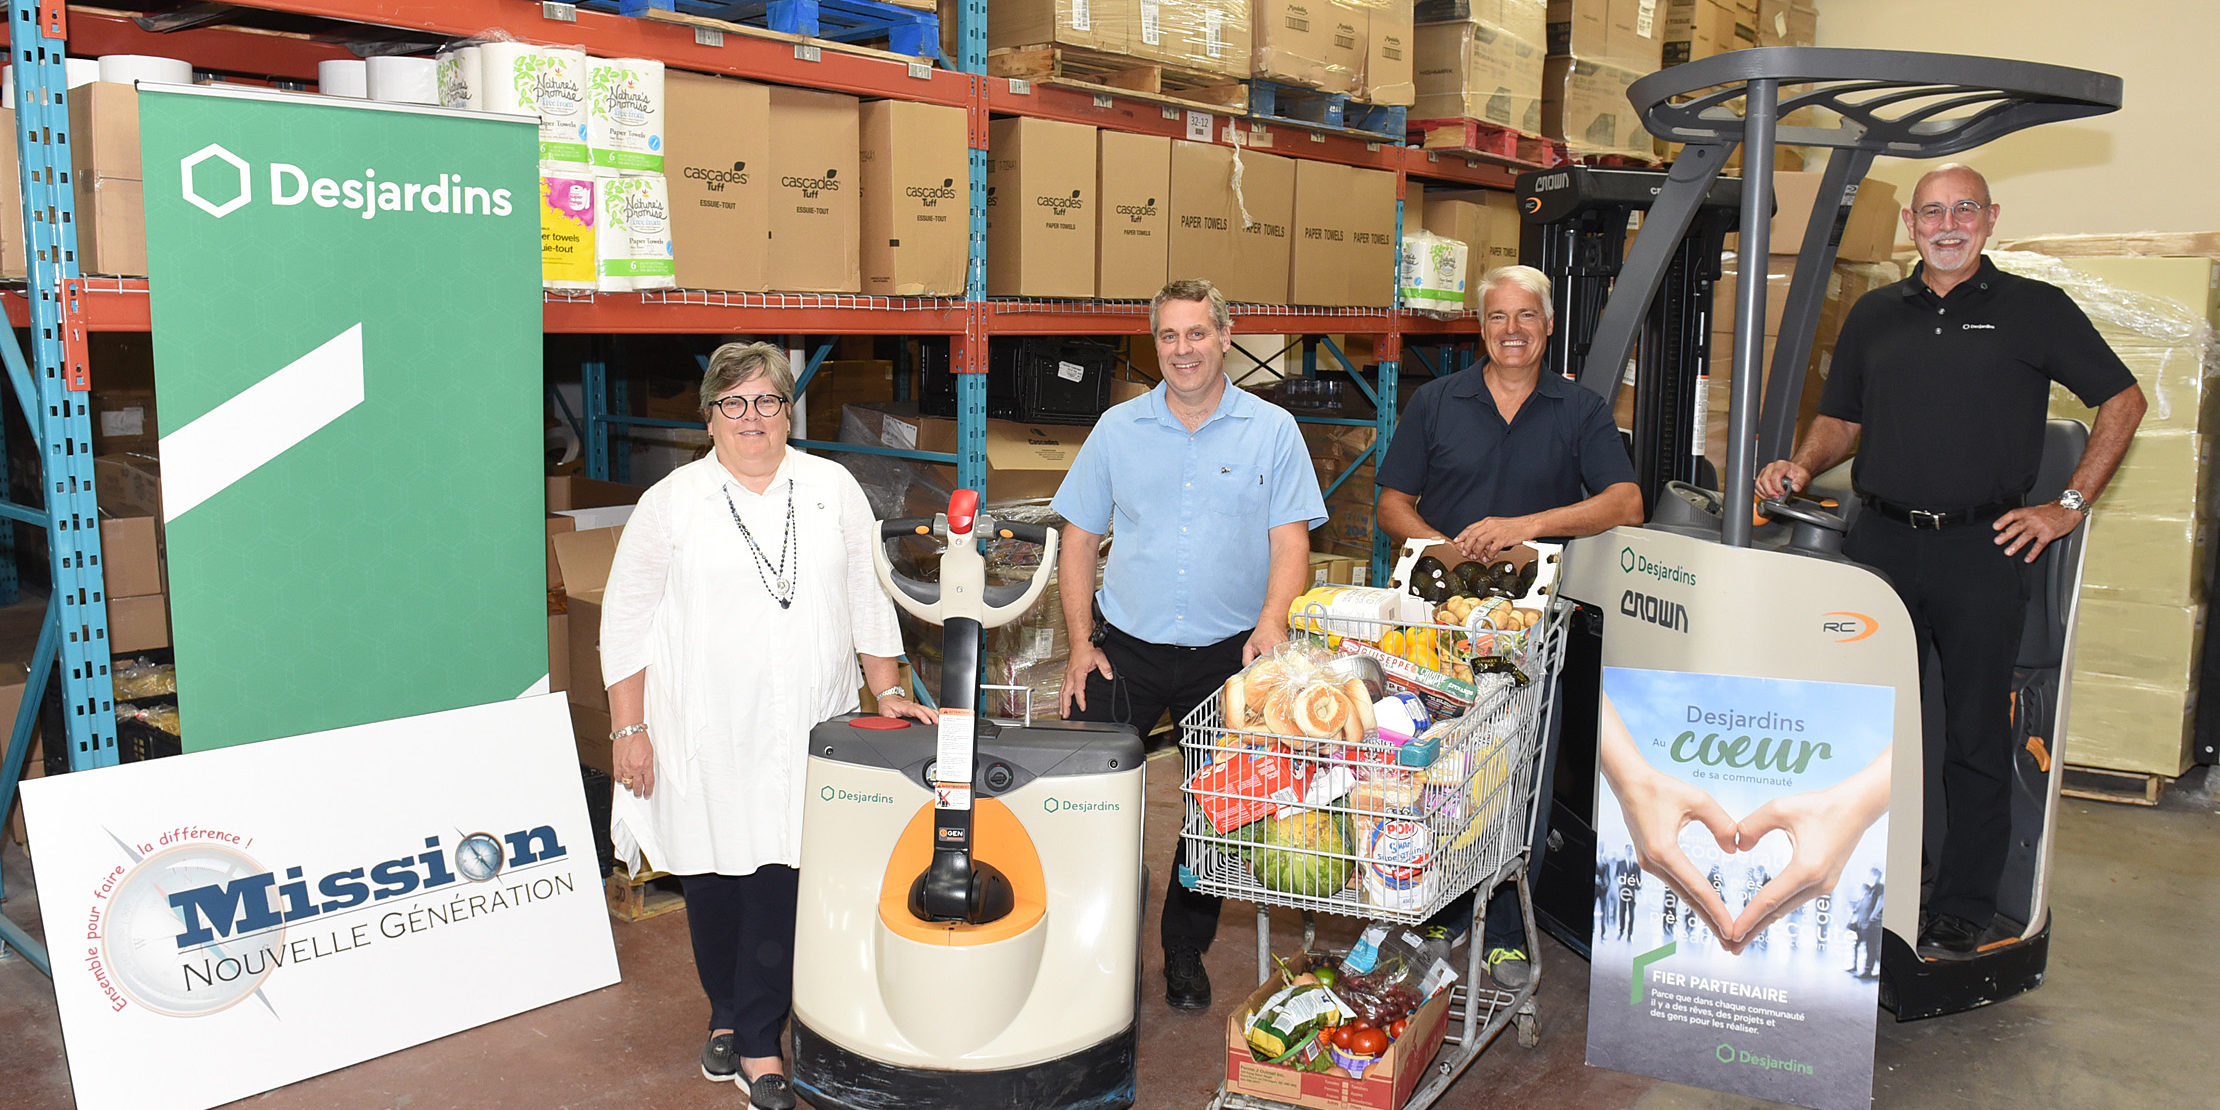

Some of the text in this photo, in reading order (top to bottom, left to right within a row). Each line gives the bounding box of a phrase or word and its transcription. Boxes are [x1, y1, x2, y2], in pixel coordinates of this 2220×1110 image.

[535, 73, 579, 92] Nature's
[533, 87, 584, 102] Promise
[610, 84, 651, 104] Nature's
[606, 98, 655, 114] Promise
[540, 120, 577, 128] aper Towels
[1190, 115, 1209, 128] 32-12
[610, 128, 646, 138] Paper Towels
[609, 152, 616, 161] 6
[684, 166, 748, 185] cascades
[781, 174, 839, 192] cascades
[1534, 172, 1570, 192] CROWN
[270, 163, 513, 220] Desjardins
[706, 181, 725, 193] Tuff
[802, 188, 820, 200] Tuff
[906, 185, 956, 199] cascades
[624, 194, 664, 210] Nature's
[700, 200, 736, 210] ESSUIE-TOUT
[922, 198, 937, 207] Tuff
[1036, 195, 1082, 209] cascades
[1116, 203, 1157, 216] cascades
[623, 208, 667, 222] Promise
[796, 206, 830, 216] ESSUIE-TOUT
[916, 214, 947, 222] ESSUIE-TOUT
[1053, 207, 1066, 216] Tuff
[1130, 214, 1142, 223] Tuff
[1046, 222, 1076, 230] PAPER TOWELS
[1181, 215, 1228, 231] PAPER TOWELS
[1264, 223, 1284, 238] TOWELS
[552, 233, 580, 243] towels
[629, 237, 664, 246] Paper Towels
[1304, 227, 1344, 242] PAPER TOWELS
[1353, 232, 1390, 245] PAPER TOWELS
[631, 261, 637, 270] 6
[1638, 555, 1697, 586] Desjardins
[1621, 589, 1689, 634] CROWN
[1822, 622, 1856, 633] RC
[1686, 705, 1805, 733] Desjardins
[1652, 738, 1666, 748] Au
[1692, 769, 1706, 778] de
[1722, 773, 1793, 787] communauté
[838, 789, 894, 804] Desjardins
[1062, 800, 1120, 813] Desjardins
[159, 826, 241, 846] différence
[1386, 824, 1415, 835] POM
[137, 843, 154, 855] la
[94, 864, 125, 899] faire
[168, 824, 567, 949] Mission
[87, 906, 101, 940] pour
[183, 872, 574, 992] NOUVELLE GÉNÉRATION
[85, 946, 127, 1012] Ensemble
[1652, 970, 1788, 1004] FIER PARTENAIRE
[1651, 988, 1806, 1022] Parce que dans chaque communauté
[1650, 999, 1656, 1007] il
[1658, 1002, 1664, 1010] y
[1672, 1002, 1688, 1012] des
[1690, 1006, 1714, 1018] rêves,
[1716, 1009, 1732, 1020] des
[1734, 1013, 1764, 1028] projets
[1766, 1018, 1776, 1028] et
[1650, 1009, 1760, 1035] des gens pour les réaliser.
[1740, 1050, 1814, 1075] Desjardins
